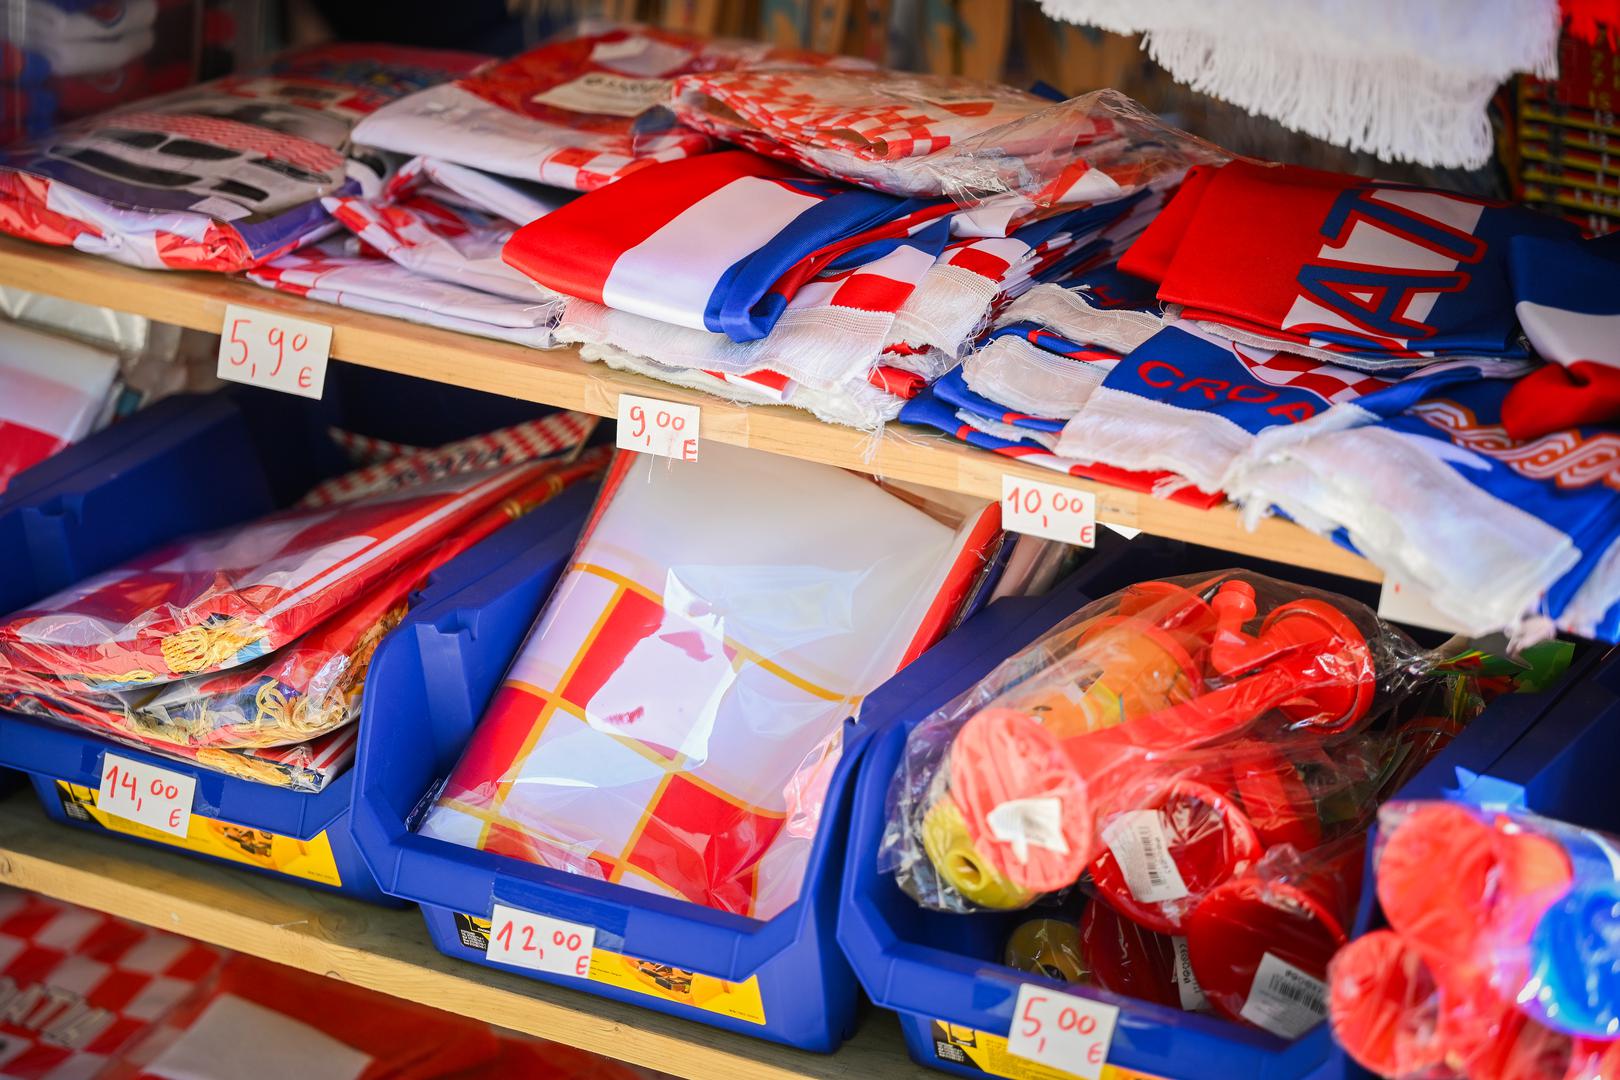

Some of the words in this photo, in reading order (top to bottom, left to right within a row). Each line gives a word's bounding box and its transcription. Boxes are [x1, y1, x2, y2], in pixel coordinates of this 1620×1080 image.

[229, 319, 308, 378] 5,90
[629, 405, 686, 447] 9,00
[1007, 486, 1084, 529] 10,00
[105, 765, 179, 813] 14,00
[496, 920, 582, 961] 12,00
[1021, 996, 1097, 1053] 5,00
